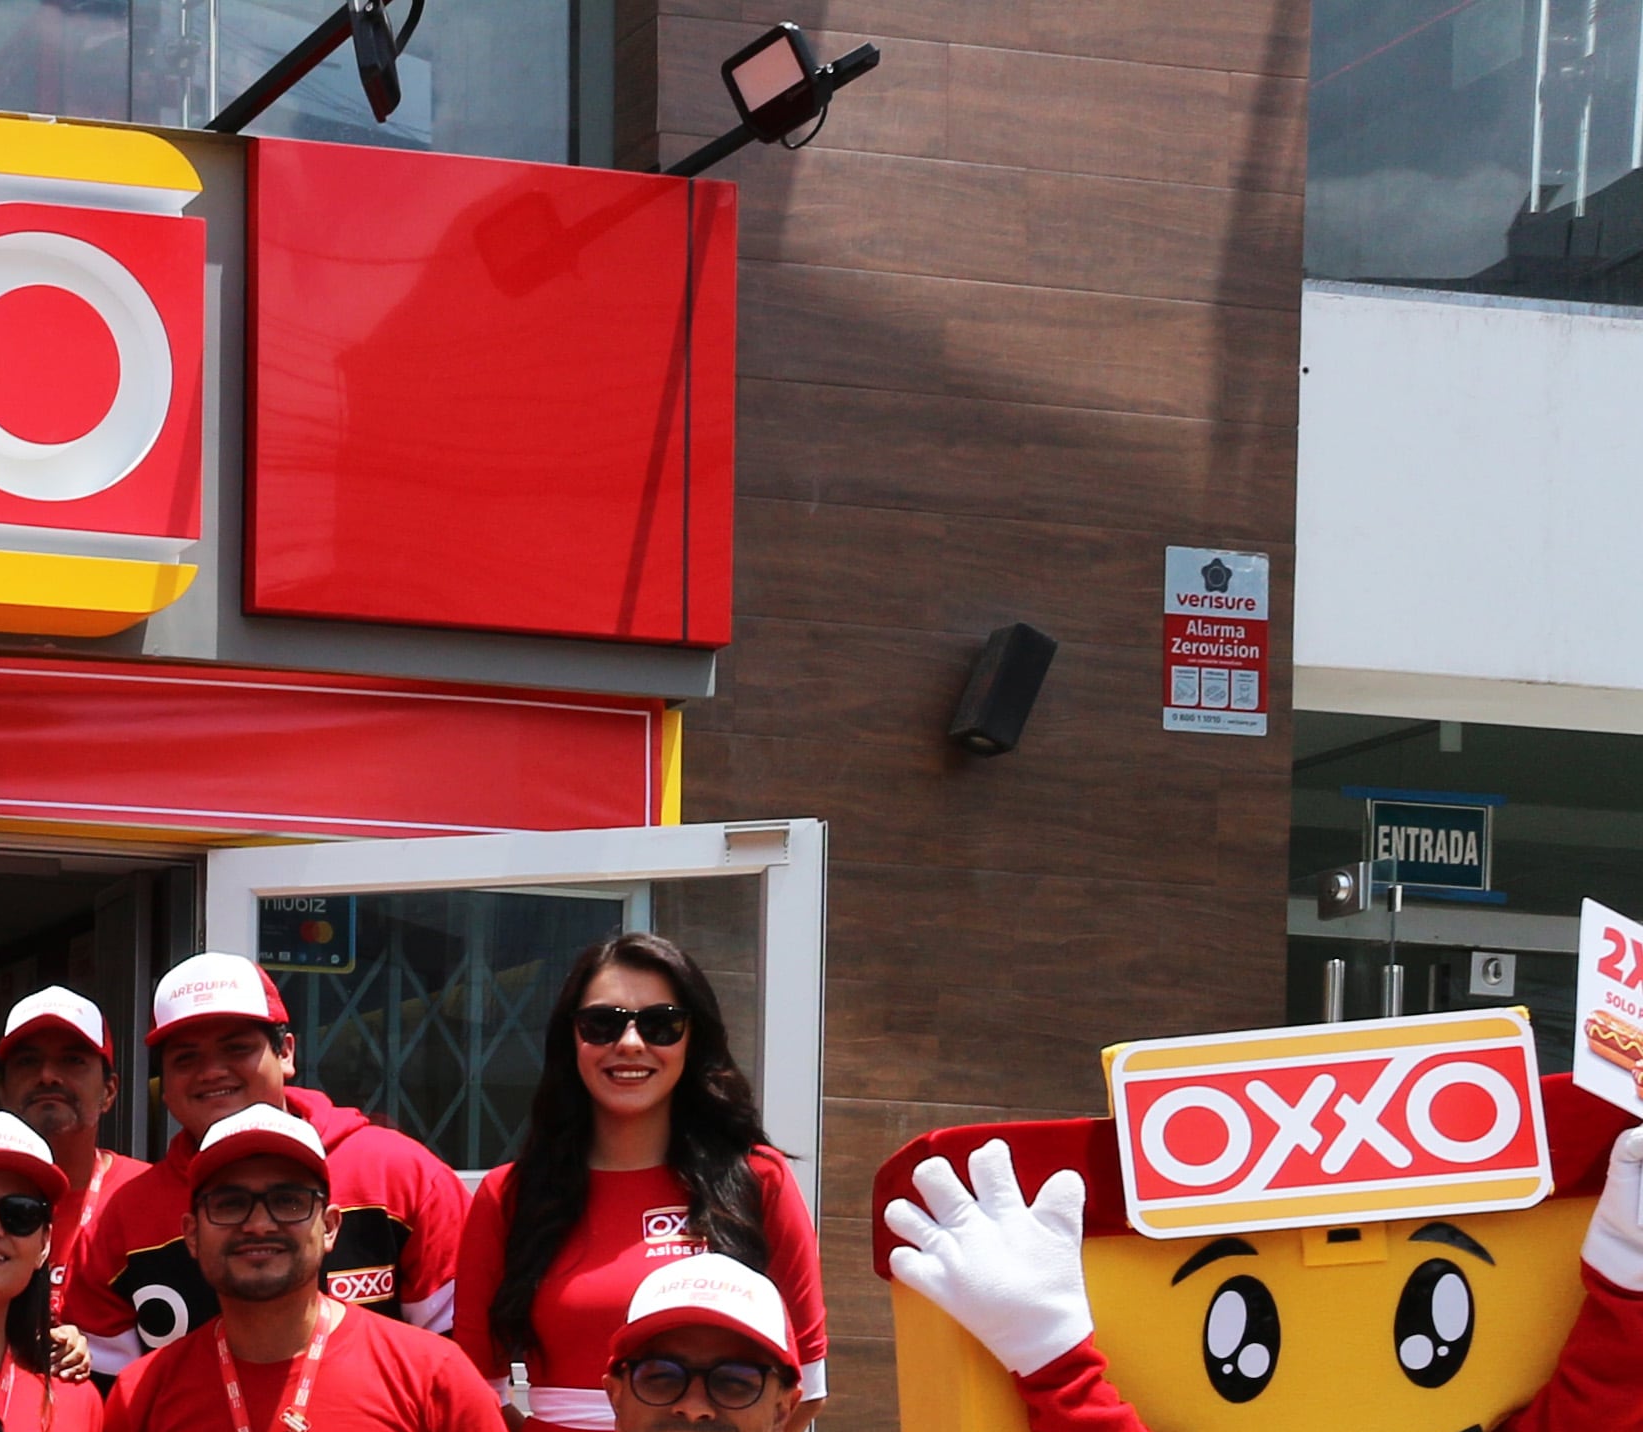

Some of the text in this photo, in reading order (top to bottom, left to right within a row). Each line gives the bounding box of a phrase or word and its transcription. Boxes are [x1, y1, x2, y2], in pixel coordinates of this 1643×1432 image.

[1176, 592, 1256, 612] verisure
[1185, 620, 1245, 639] Alarma
[1171, 637, 1260, 659] Zerovision
[1377, 825, 1479, 867] ENTRADA
[168, 978, 240, 1001] AREQUIPA
[1605, 991, 1636, 1017] SOLO
[1141, 1061, 1522, 1187] OXXO
[646, 1242, 671, 1257] ASÍ
[329, 1269, 393, 1300] OXXO
[653, 1277, 755, 1304] AREQUIPA
